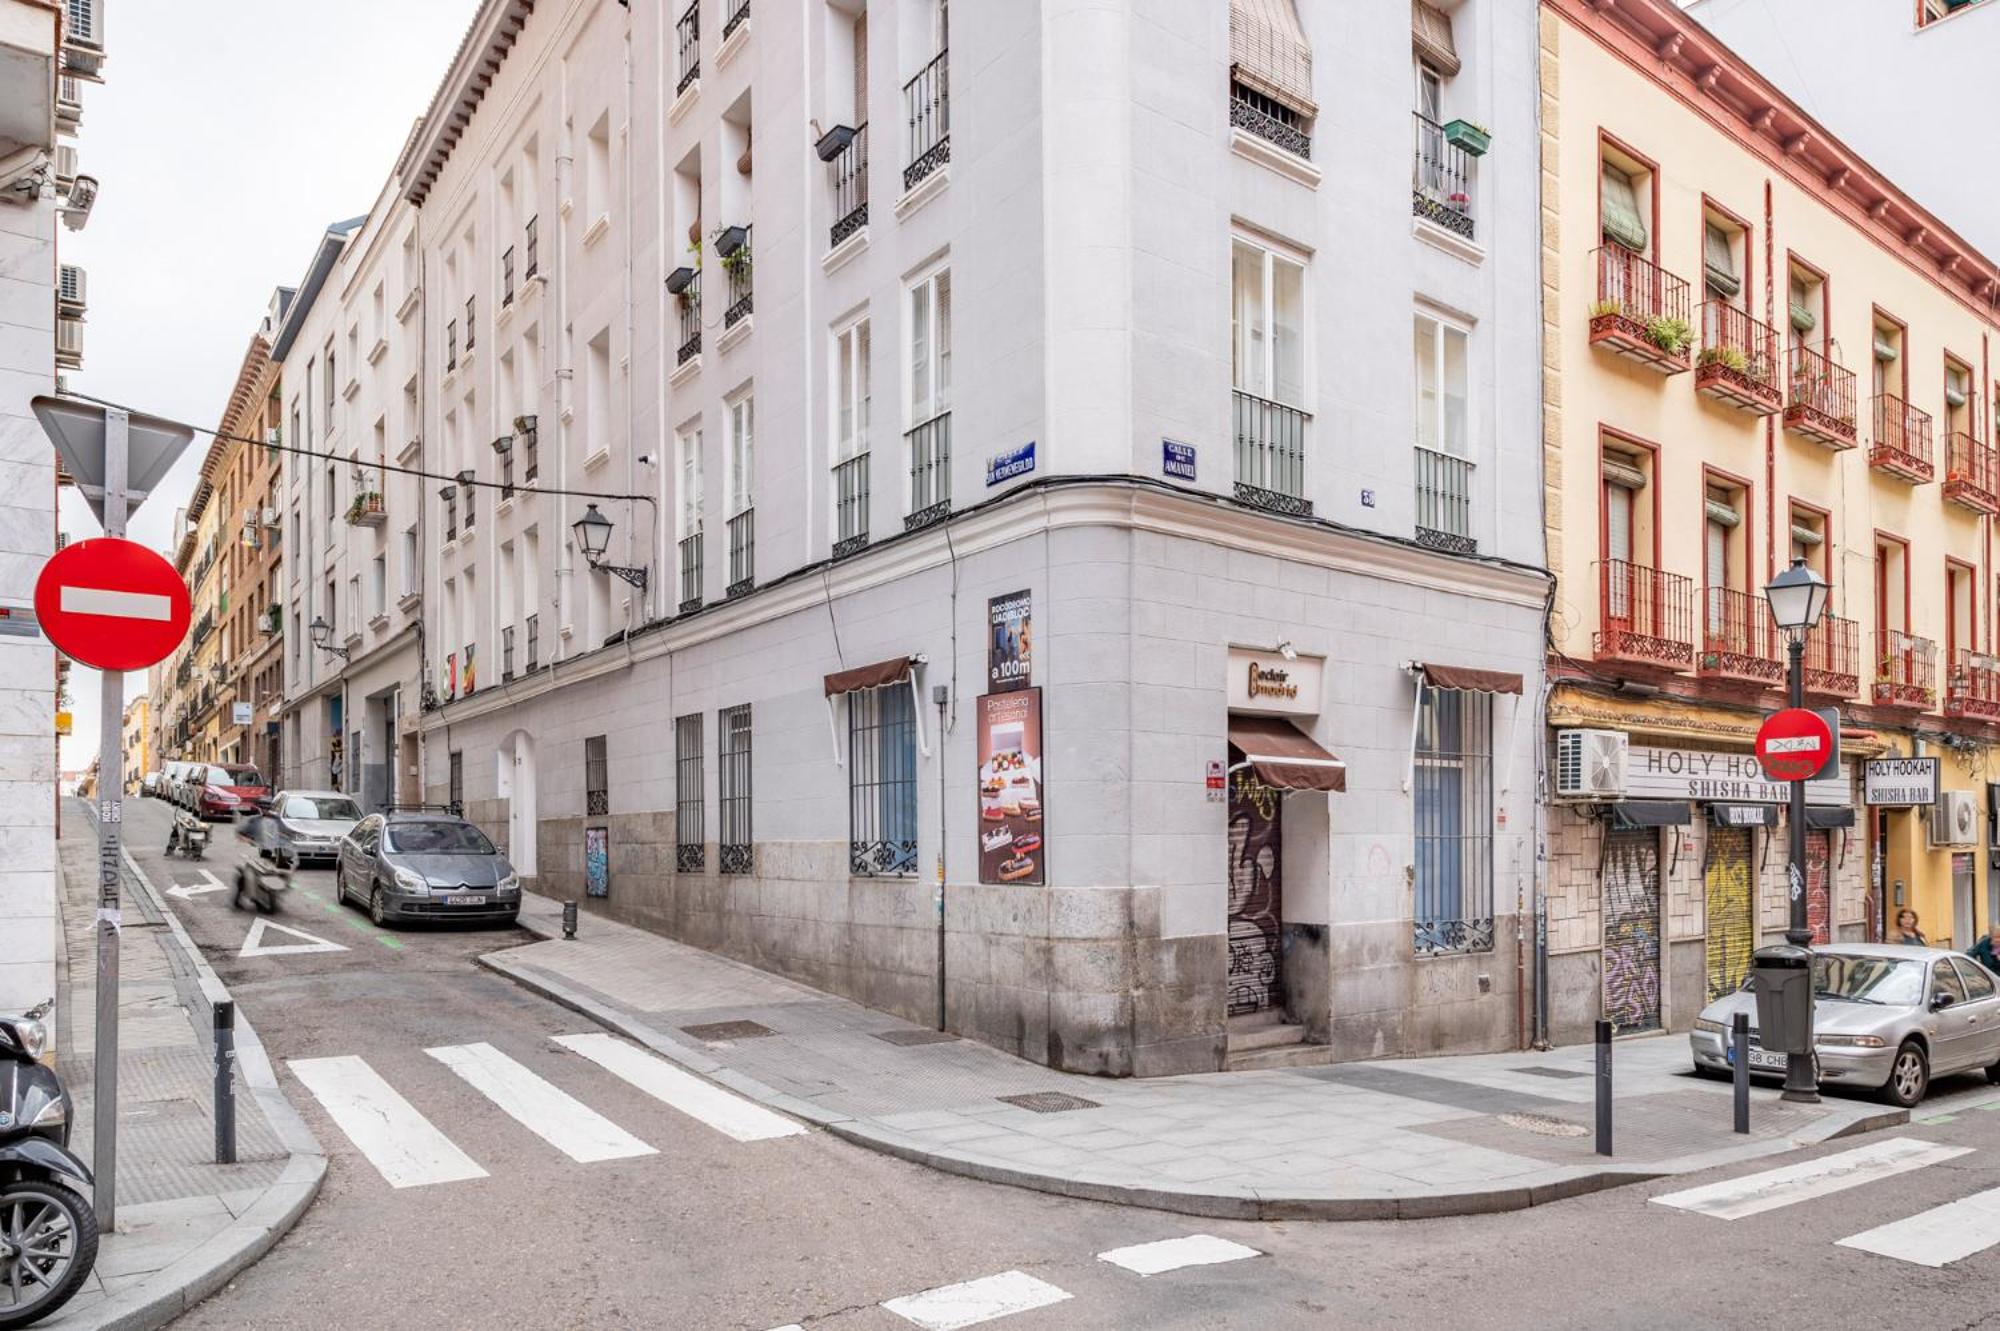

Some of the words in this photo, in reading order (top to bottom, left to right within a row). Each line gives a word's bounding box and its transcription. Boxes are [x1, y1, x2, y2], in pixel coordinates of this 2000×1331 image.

[1168, 444, 1193, 457] CALLE
[1165, 460, 1195, 477] AMANIEL
[991, 667, 1000, 679] a
[1000, 660, 1030, 677] 100m
[1648, 749, 1714, 776] HOLY
[1868, 761, 1892, 776] HOLY
[1893, 760, 1932, 776] HOOKAH
[1688, 780, 1751, 800] SHISHA
[1759, 783, 1789, 801] BAR
[1871, 788, 1906, 802] SHISHA
[1909, 787, 1929, 802] BAR
